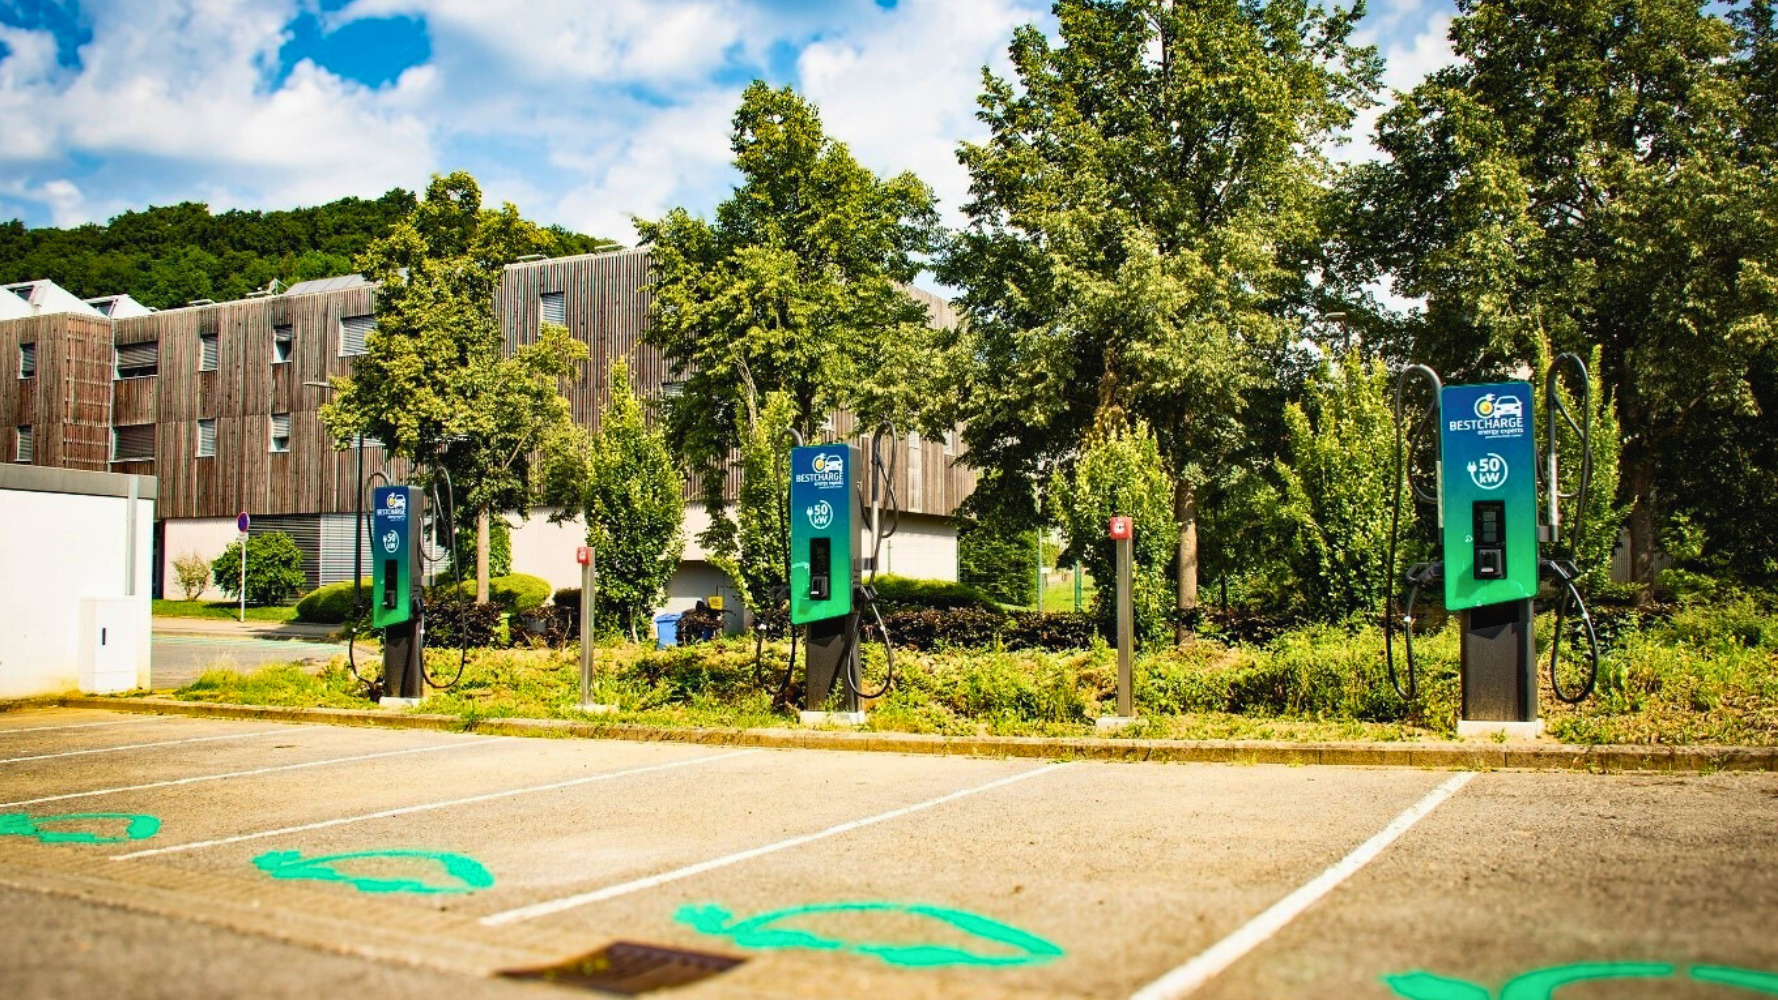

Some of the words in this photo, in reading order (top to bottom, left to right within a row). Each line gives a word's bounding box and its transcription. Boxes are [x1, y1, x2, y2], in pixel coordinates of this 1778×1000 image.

[1449, 417, 1524, 431] BESTCHARGE
[1479, 457, 1500, 472] 50
[796, 472, 844, 482] BESTCHARGE
[1479, 472, 1500, 484] kW
[814, 503, 828, 515] 50
[814, 515, 828, 524] kW
